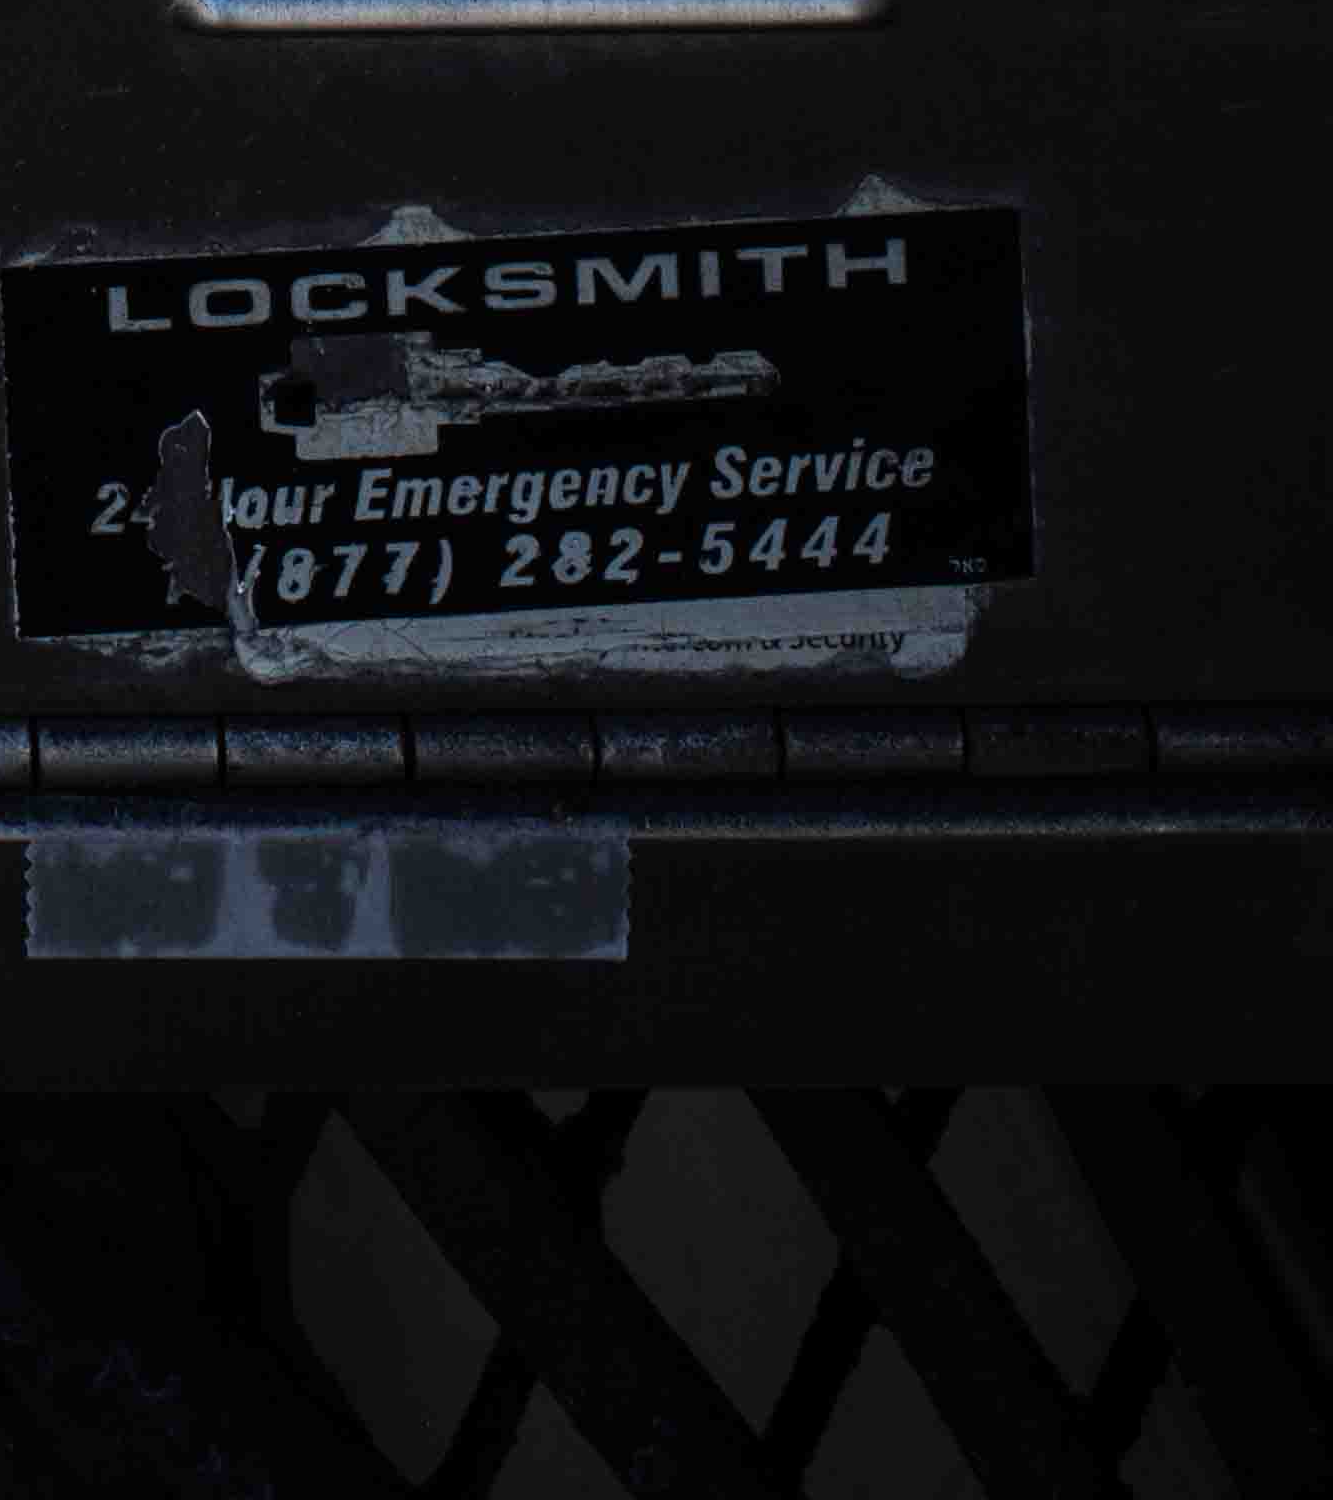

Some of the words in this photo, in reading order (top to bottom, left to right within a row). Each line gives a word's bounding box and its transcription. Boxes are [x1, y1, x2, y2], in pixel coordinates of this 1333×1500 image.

[107, 238, 908, 333] LOCKSMITH
[352, 454, 691, 524] Emergency
[710, 436, 934, 501] Service
[498, 510, 894, 588] 282-5444
